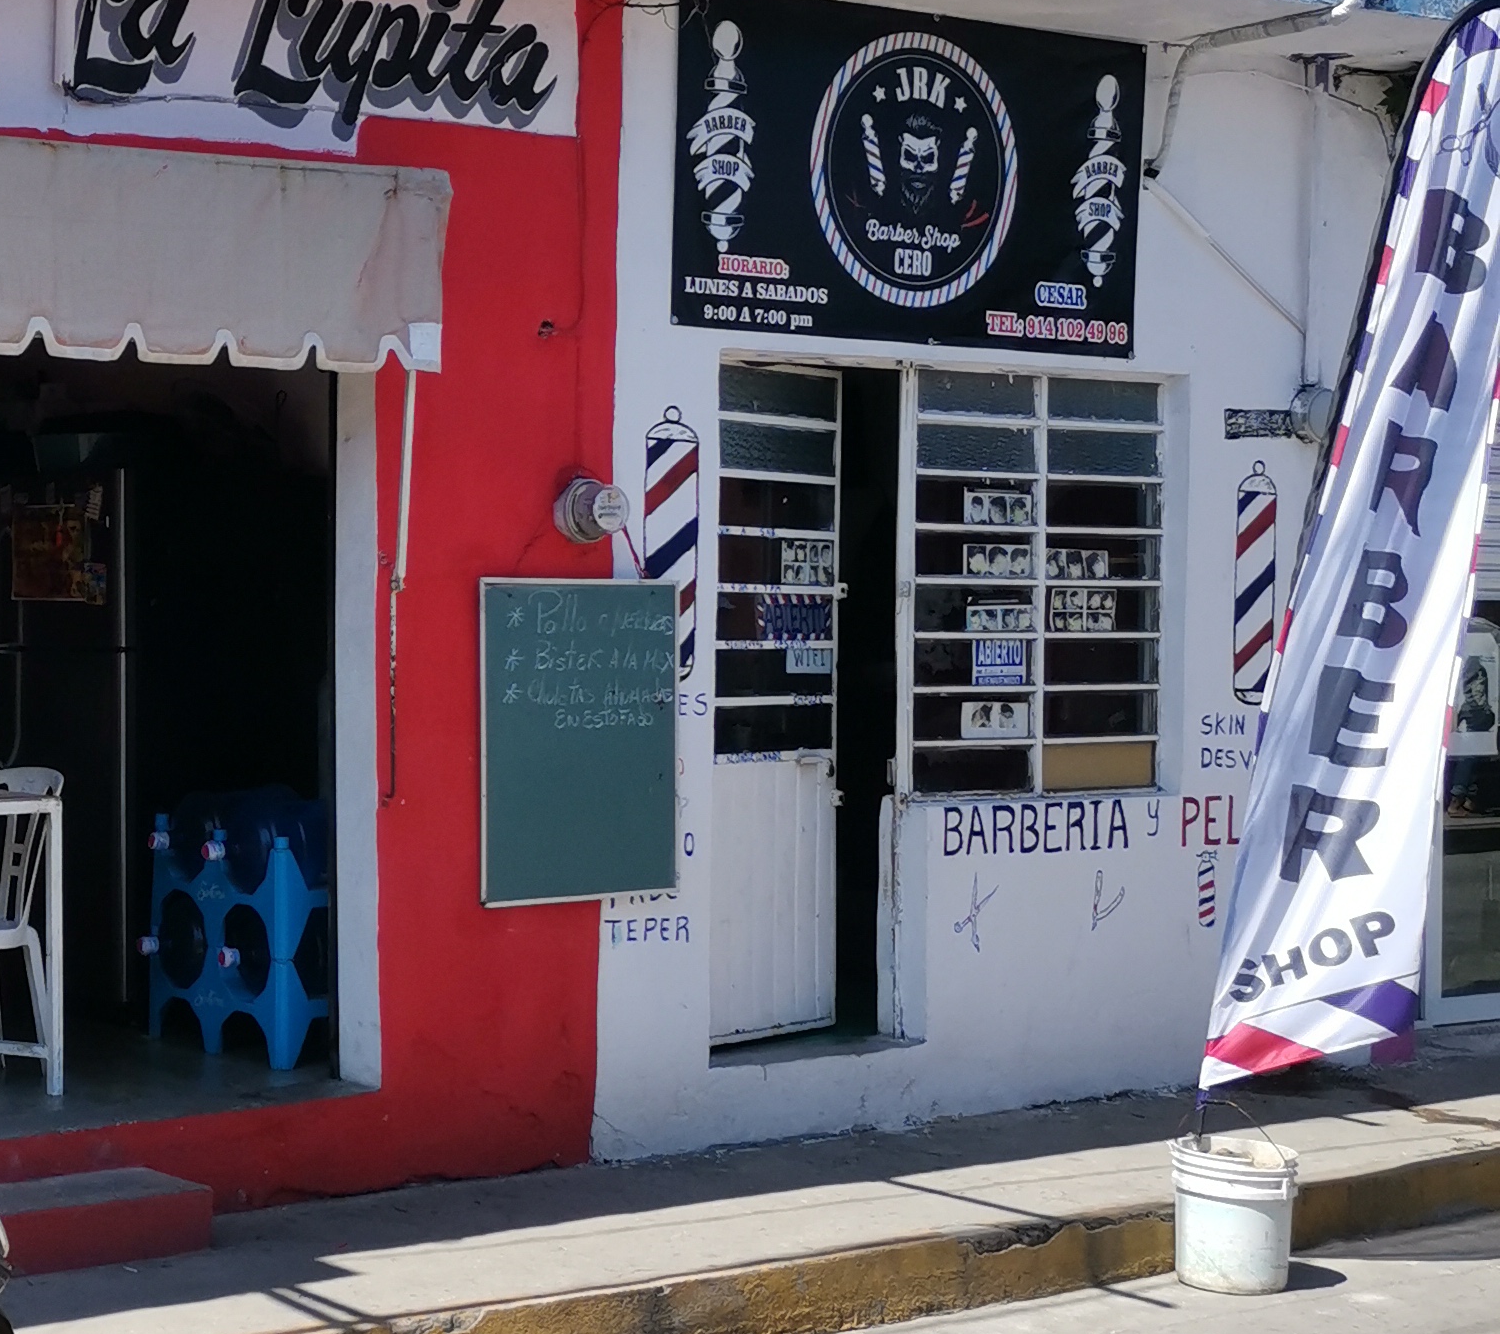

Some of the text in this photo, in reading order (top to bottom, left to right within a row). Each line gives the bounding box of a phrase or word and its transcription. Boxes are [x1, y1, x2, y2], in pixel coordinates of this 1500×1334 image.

[895, 66, 951, 109] JRK
[703, 114, 747, 135] BARBER
[711, 158, 740, 177] SHOP
[1088, 202, 1112, 218] SHOP
[865, 218, 961, 254] Barber Shop
[719, 255, 789, 278] HORARIO:
[893, 248, 933, 277] CERO
[683, 276, 829, 305] LUNES A SABADOS
[1036, 284, 1086, 308] CESAR
[703, 303, 814, 330] 9:00 A 7:00 pm
[987, 313, 1023, 334] TEL:
[1027, 316, 1054, 337] 914
[1058, 319, 1084, 339] 102
[1088, 321, 1104, 340] 49
[1278, 187, 1491, 883] BARBER
[528, 589, 587, 635] Pollo
[977, 639, 1022, 665] ABIERTO
[1200, 711, 1246, 736] SKIN
[943, 798, 1130, 857] BARBERIA
[1227, 910, 1397, 1004] SHOP
